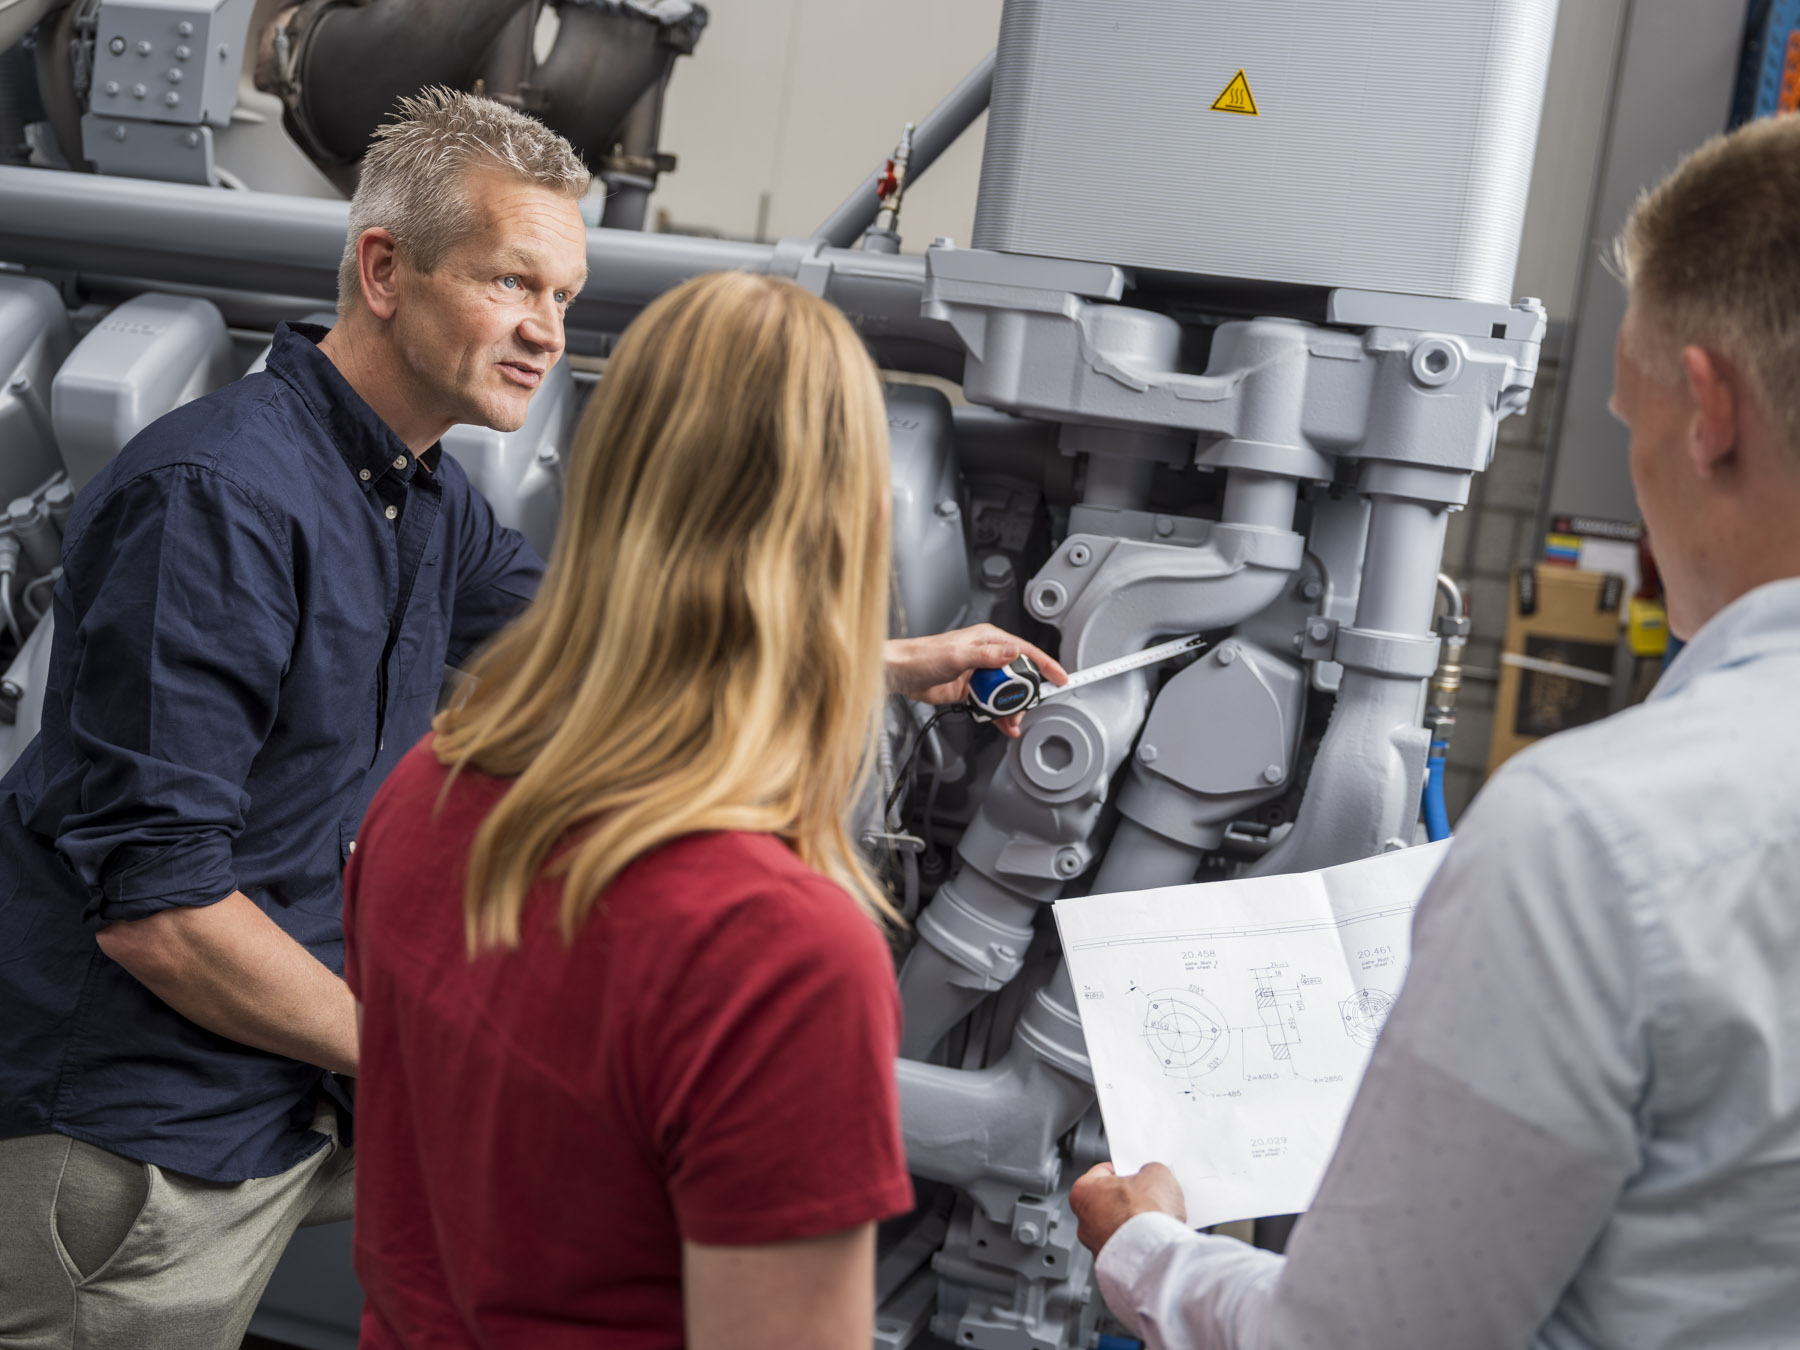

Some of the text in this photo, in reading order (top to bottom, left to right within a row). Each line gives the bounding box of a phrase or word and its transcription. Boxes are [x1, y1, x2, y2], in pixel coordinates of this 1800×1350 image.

[1181, 949, 1216, 960] 20.458
[1357, 945, 1392, 959] 20.461
[1249, 1136, 1288, 1147] 20.029
